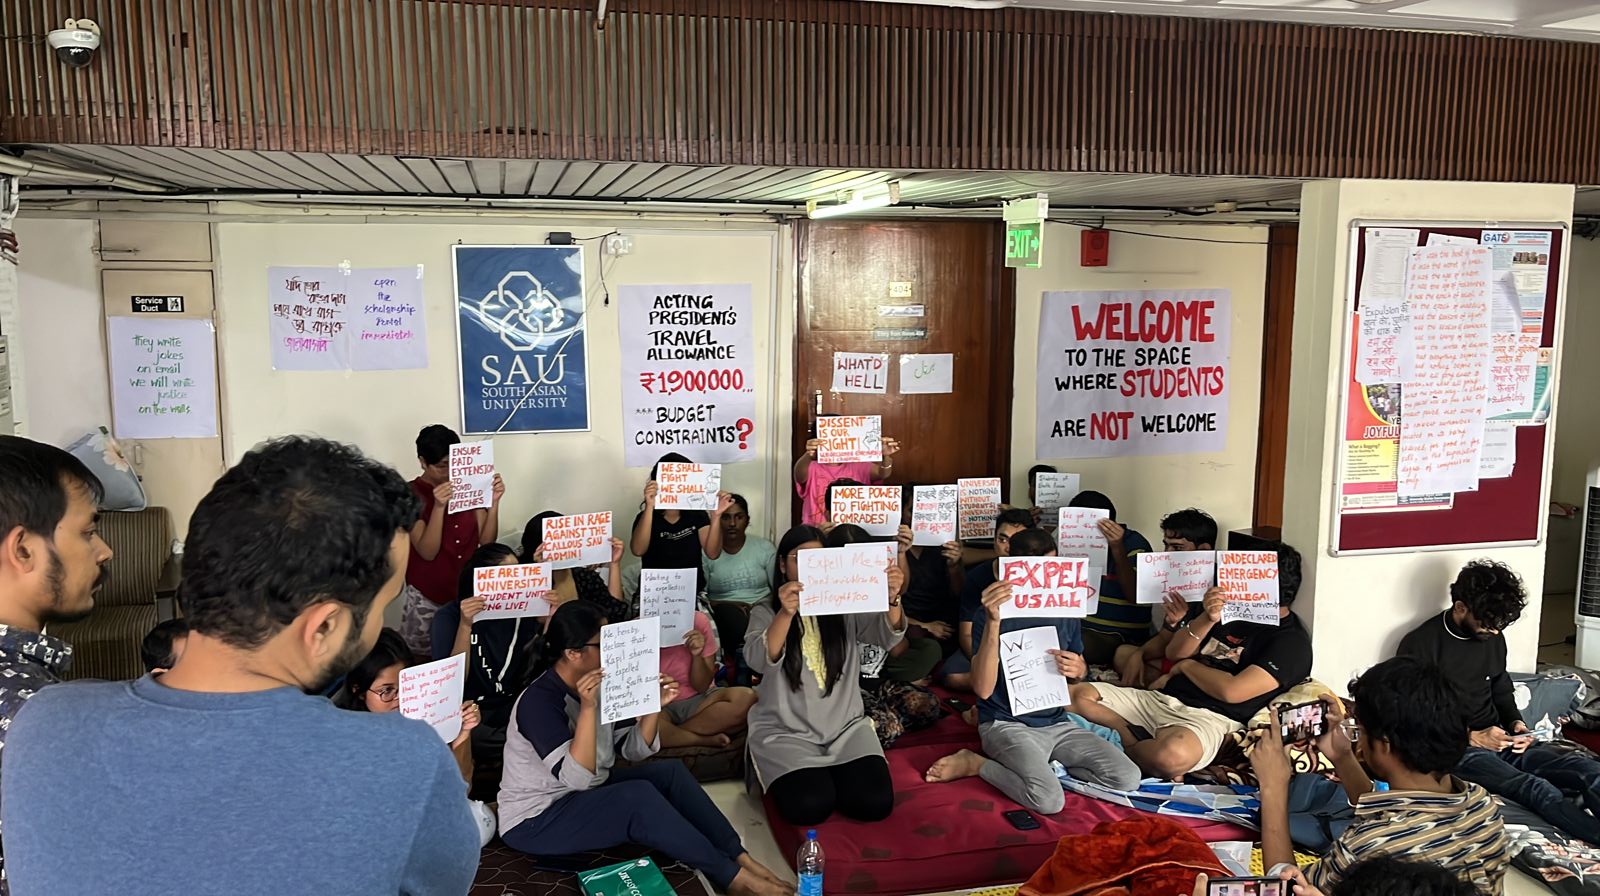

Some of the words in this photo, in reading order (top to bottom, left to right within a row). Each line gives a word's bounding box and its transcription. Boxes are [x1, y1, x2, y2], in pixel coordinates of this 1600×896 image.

[1007, 230, 1032, 258] EXIT
[1484, 233, 1506, 243] GATE
[893, 286, 909, 294] 404
[135, 296, 163, 304] Service
[653, 294, 713, 309] ACTING
[649, 306, 737, 325] PRESIDENT'S
[1071, 300, 1215, 343] WELCOME
[132, 335, 153, 352] they
[157, 337, 181, 347] write
[647, 329, 717, 346] TRAVEL
[153, 350, 184, 365] jokes
[647, 345, 736, 361] ALLOWANCE
[1065, 349, 1087, 367] TO
[1092, 348, 1126, 367] THE
[1134, 347, 1191, 366] SPACE
[137, 364, 151, 373] on
[155, 363, 181, 373] email
[481, 354, 567, 386] SAU
[837, 355, 882, 371] WHAT'D
[150, 376, 168, 387] will
[845, 375, 884, 390] HELL
[1055, 373, 1117, 391] WHERE
[1120, 366, 1224, 399] STUDENTS
[157, 389, 187, 404] justice
[482, 387, 527, 398] SOUTH
[530, 385, 567, 397] ASIAN
[139, 406, 151, 414] on
[482, 397, 568, 410] UNIVERSITY
[656, 404, 716, 423] BUDGET
[819, 416, 866, 428] DISSENT
[1051, 419, 1086, 438] ARE
[1090, 411, 1135, 441] NOT
[1141, 413, 1217, 433] WELCOME
[819, 429, 828, 438] IS
[831, 428, 849, 437] OUR
[452, 446, 482, 456] ENSURE
[452, 456, 473, 466] PAID
[661, 463, 674, 472] WE
[675, 463, 703, 473] SHALL
[661, 474, 688, 482] FIGHT
[660, 484, 674, 493] WE
[676, 484, 705, 493] SHALL
[834, 487, 865, 499] MORE
[868, 487, 901, 499] POWER
[450, 497, 484, 512] BATCHES
[660, 494, 678, 503] WIN
[833, 501, 846, 512] TO
[851, 501, 899, 511] FIGHTING
[546, 517, 571, 529] RISE
[574, 515, 584, 526] IN
[587, 512, 610, 525] RAGE
[833, 513, 889, 524] COMRADES!
[544, 528, 587, 540] AGAINST
[589, 526, 607, 536] THE
[961, 528, 995, 537] DISSENT
[543, 540, 582, 551] CALLOUS
[586, 536, 602, 546] SAU
[1145, 554, 1170, 565] Open
[1221, 553, 1277, 564] UNDECLARED
[478, 569, 495, 580] WE
[498, 567, 519, 578] ARE
[521, 566, 542, 576] THE
[1003, 560, 1088, 589] EXPEL
[1219, 568, 1279, 580] EMERGENCY
[478, 577, 548, 592] UNIVERSITY!
[1219, 581, 1248, 592] NAHI
[505, 602, 529, 611] LIVE!
[1014, 594, 1042, 608] US
[1044, 592, 1081, 608] ALL
[1002, 633, 1033, 652] WE
[1008, 673, 1040, 693] THE
[1015, 691, 1061, 714] ADMIN
